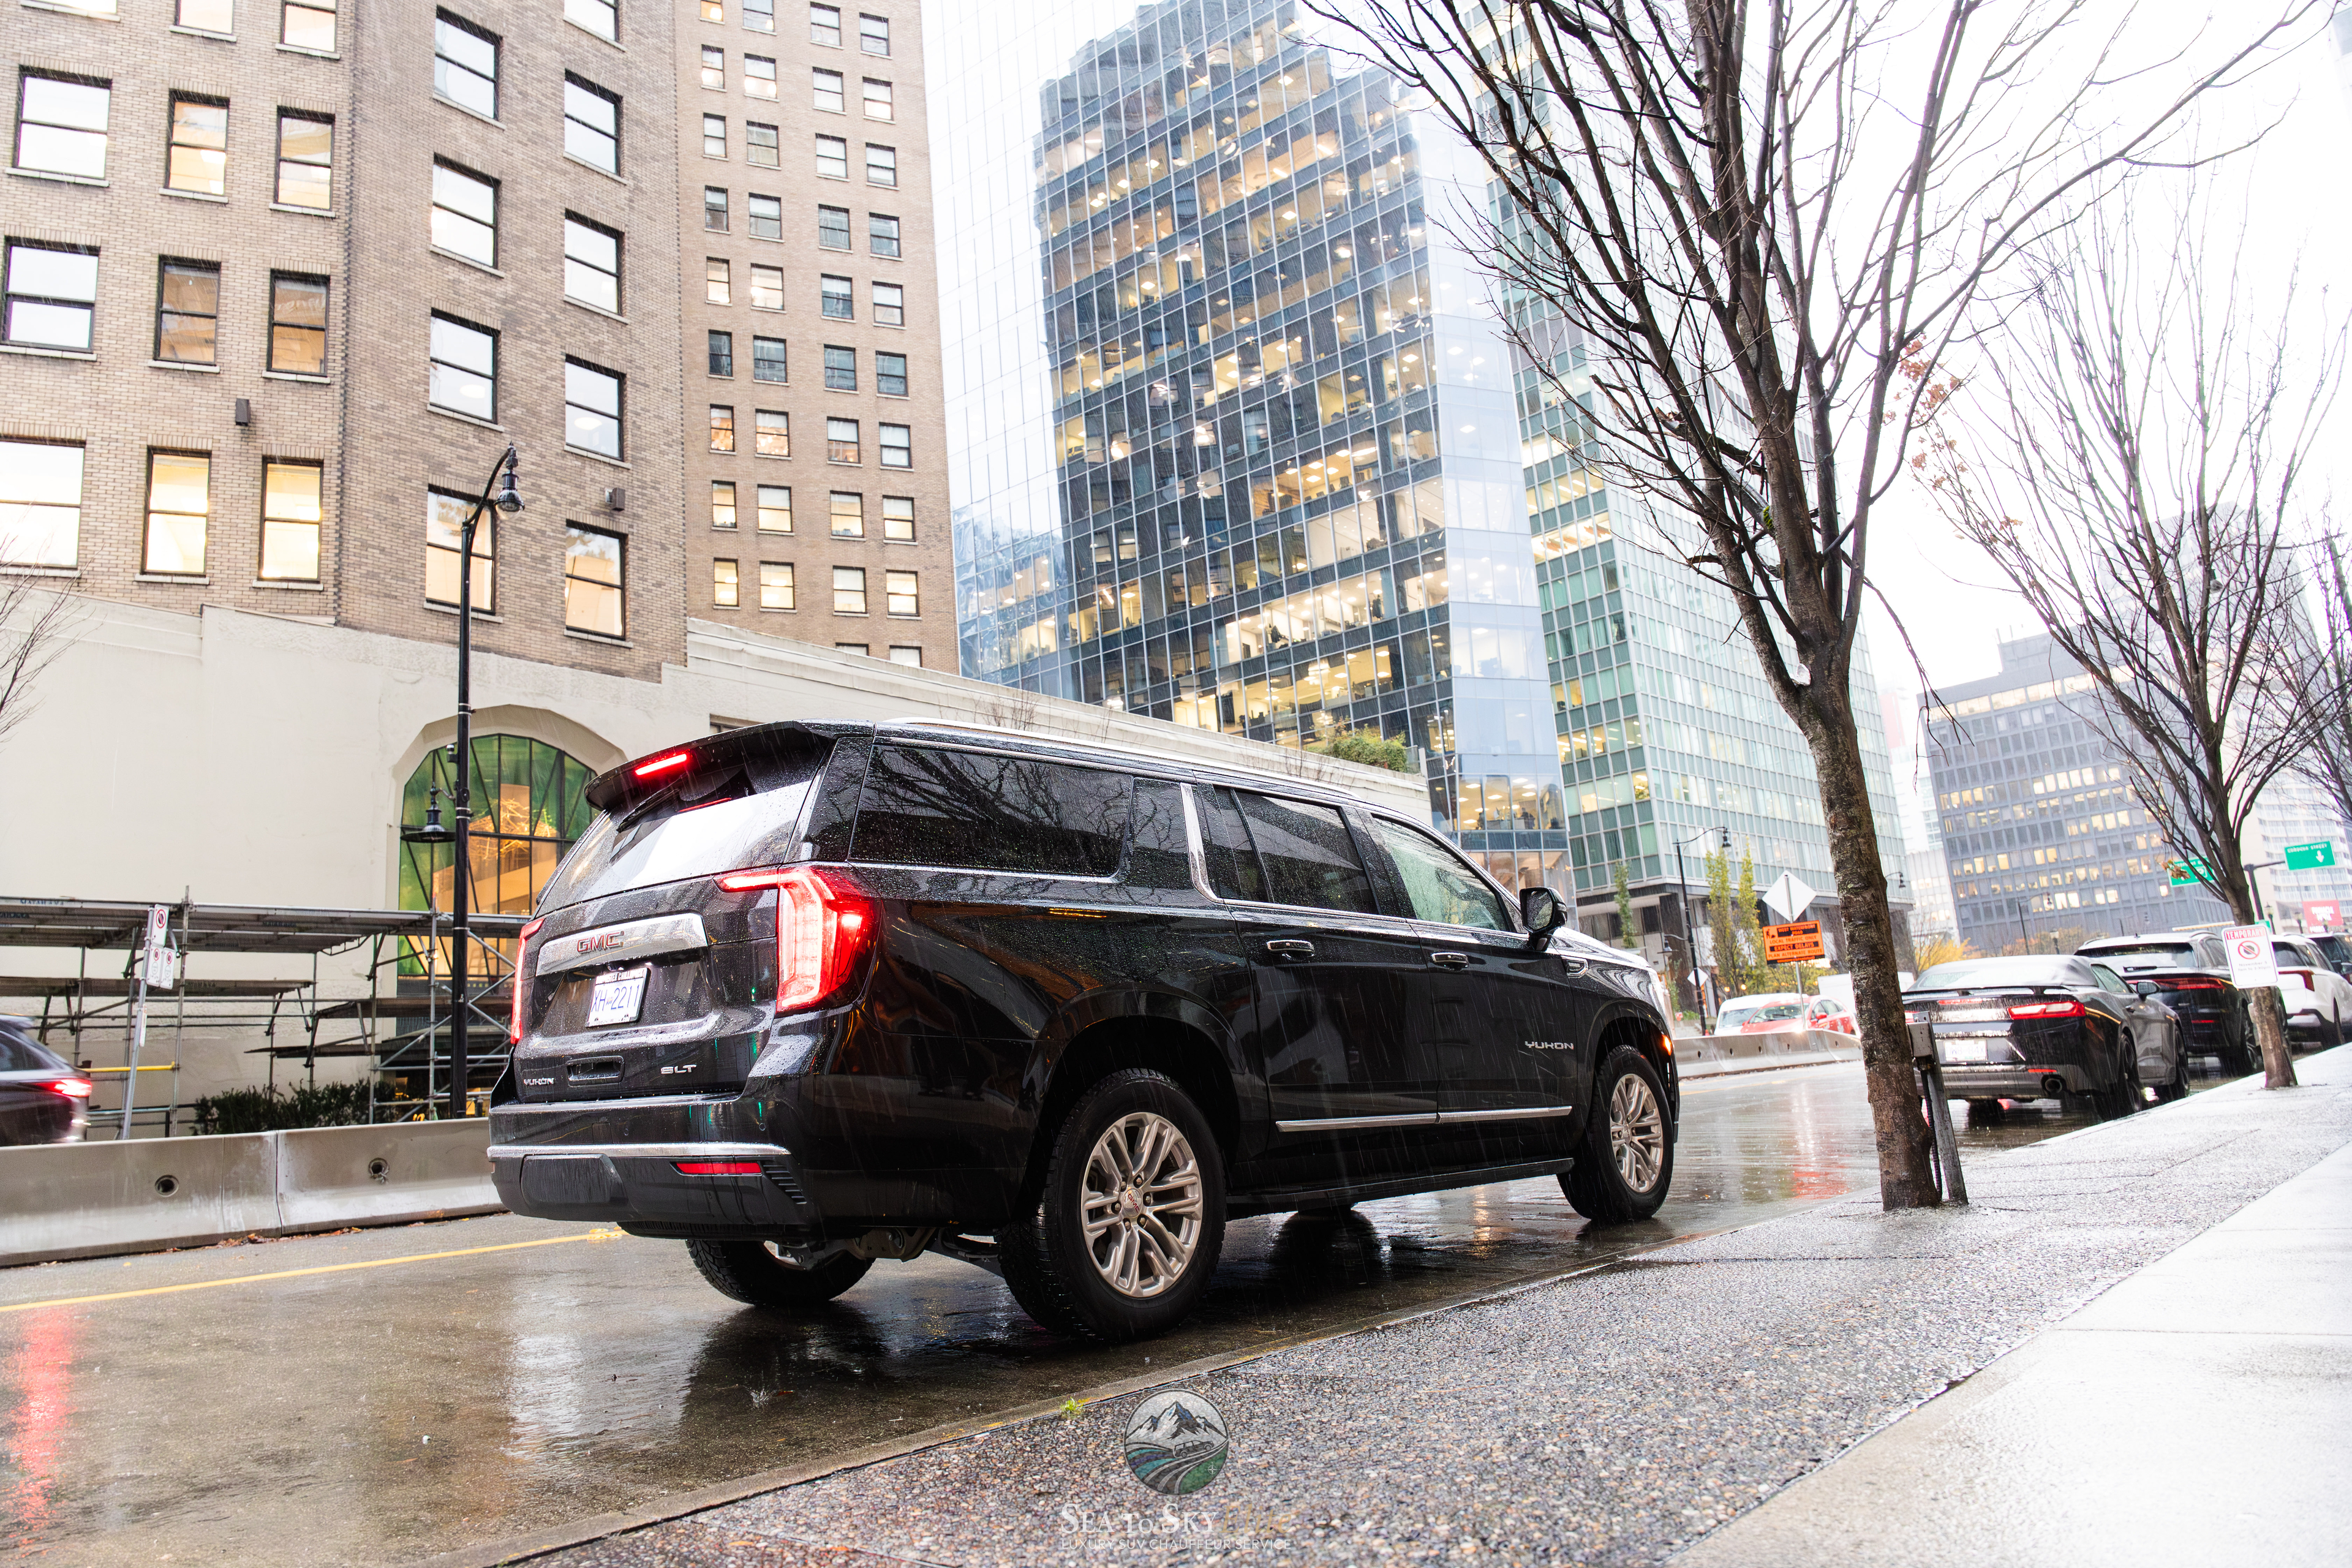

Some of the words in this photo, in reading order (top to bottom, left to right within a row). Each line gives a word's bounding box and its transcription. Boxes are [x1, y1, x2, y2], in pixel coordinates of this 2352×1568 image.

[2226, 928, 2264, 940] TEMPORARY
[577, 930, 625, 954] GMC
[591, 989, 607, 1012] XH
[611, 984, 640, 1010] 2211
[1525, 1041, 1574, 1050] YUKON
[660, 1064, 697, 1074] SLT
[524, 1077, 554, 1087] YUKON
[1128, 1193, 1140, 1213] GMC
